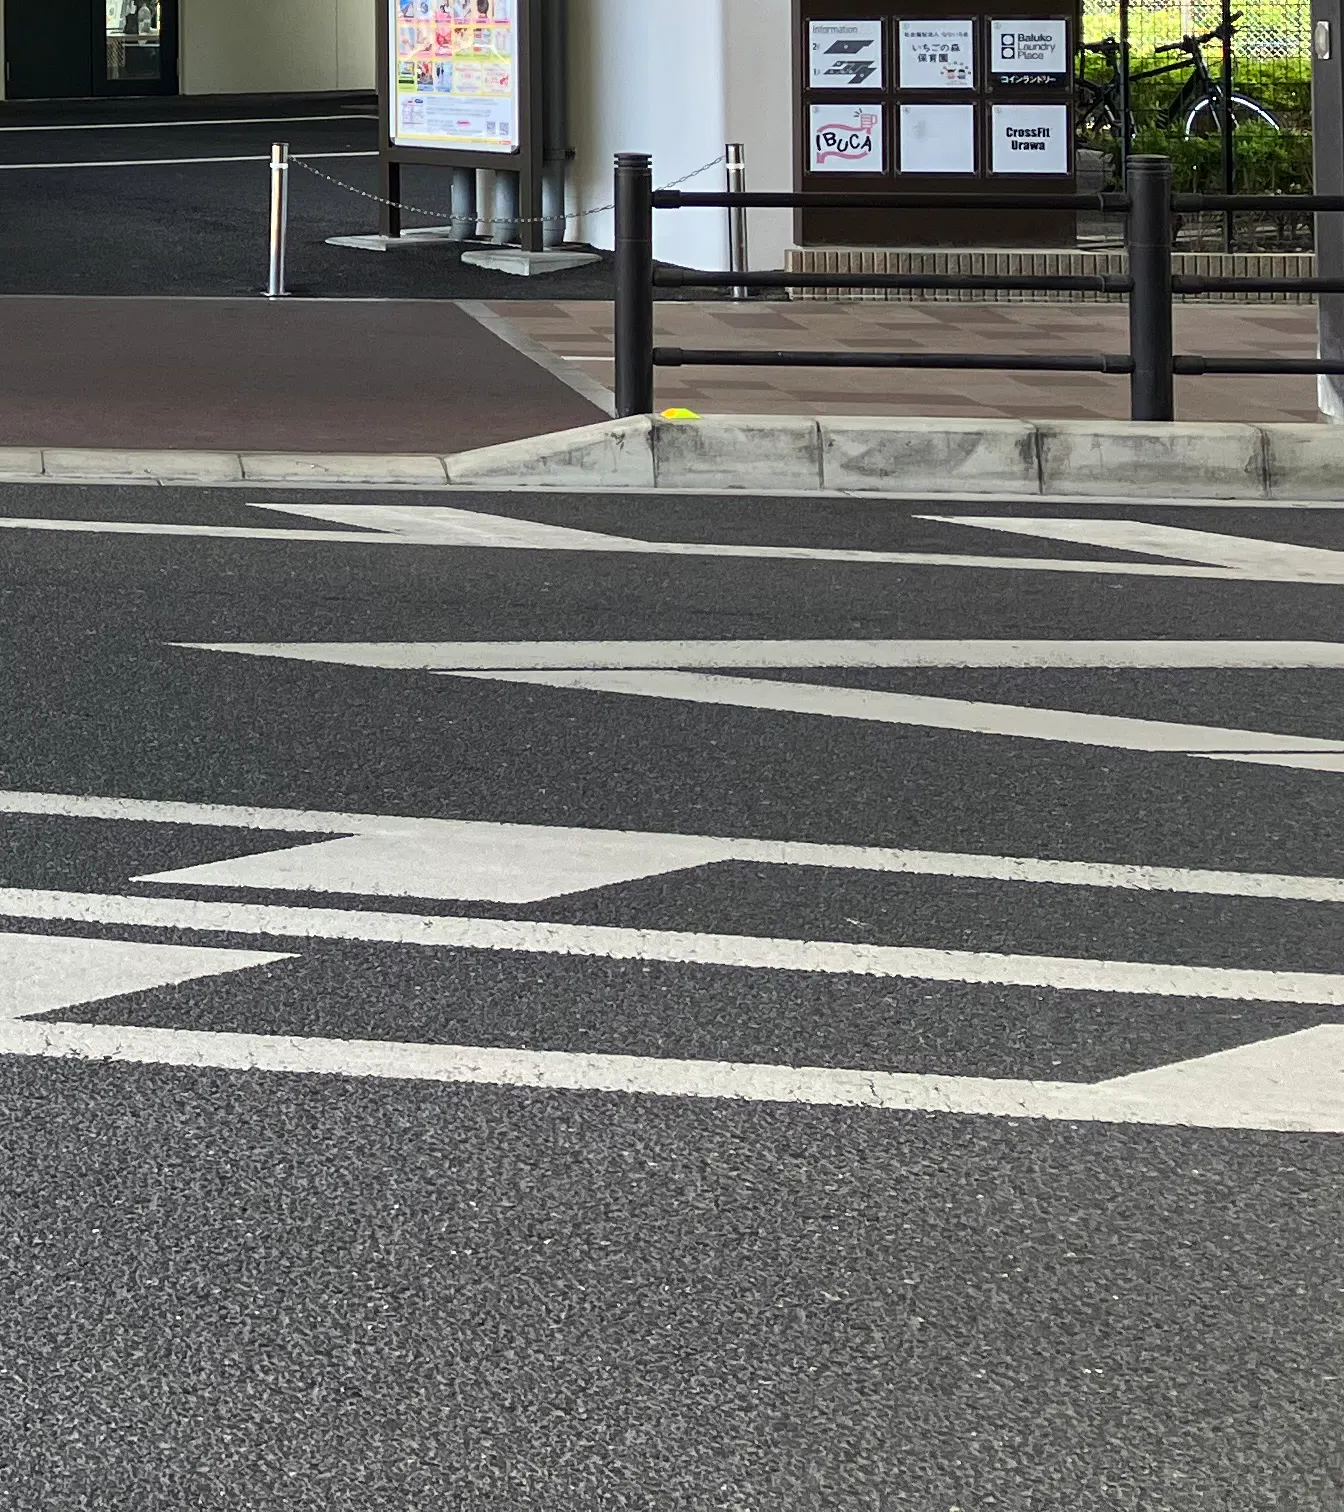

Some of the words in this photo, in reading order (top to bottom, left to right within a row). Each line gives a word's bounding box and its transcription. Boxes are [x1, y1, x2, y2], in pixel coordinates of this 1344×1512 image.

[1017, 33, 1053, 42] Baluko
[1017, 42, 1056, 53] Laundry
[1017, 50, 1044, 59] Place
[1000, 75, 1057, 84] コインランドリー
[1006, 126, 1051, 138] CrossFit
[816, 131, 872, 153] IBUCA
[1011, 139, 1046, 151] Urawa
